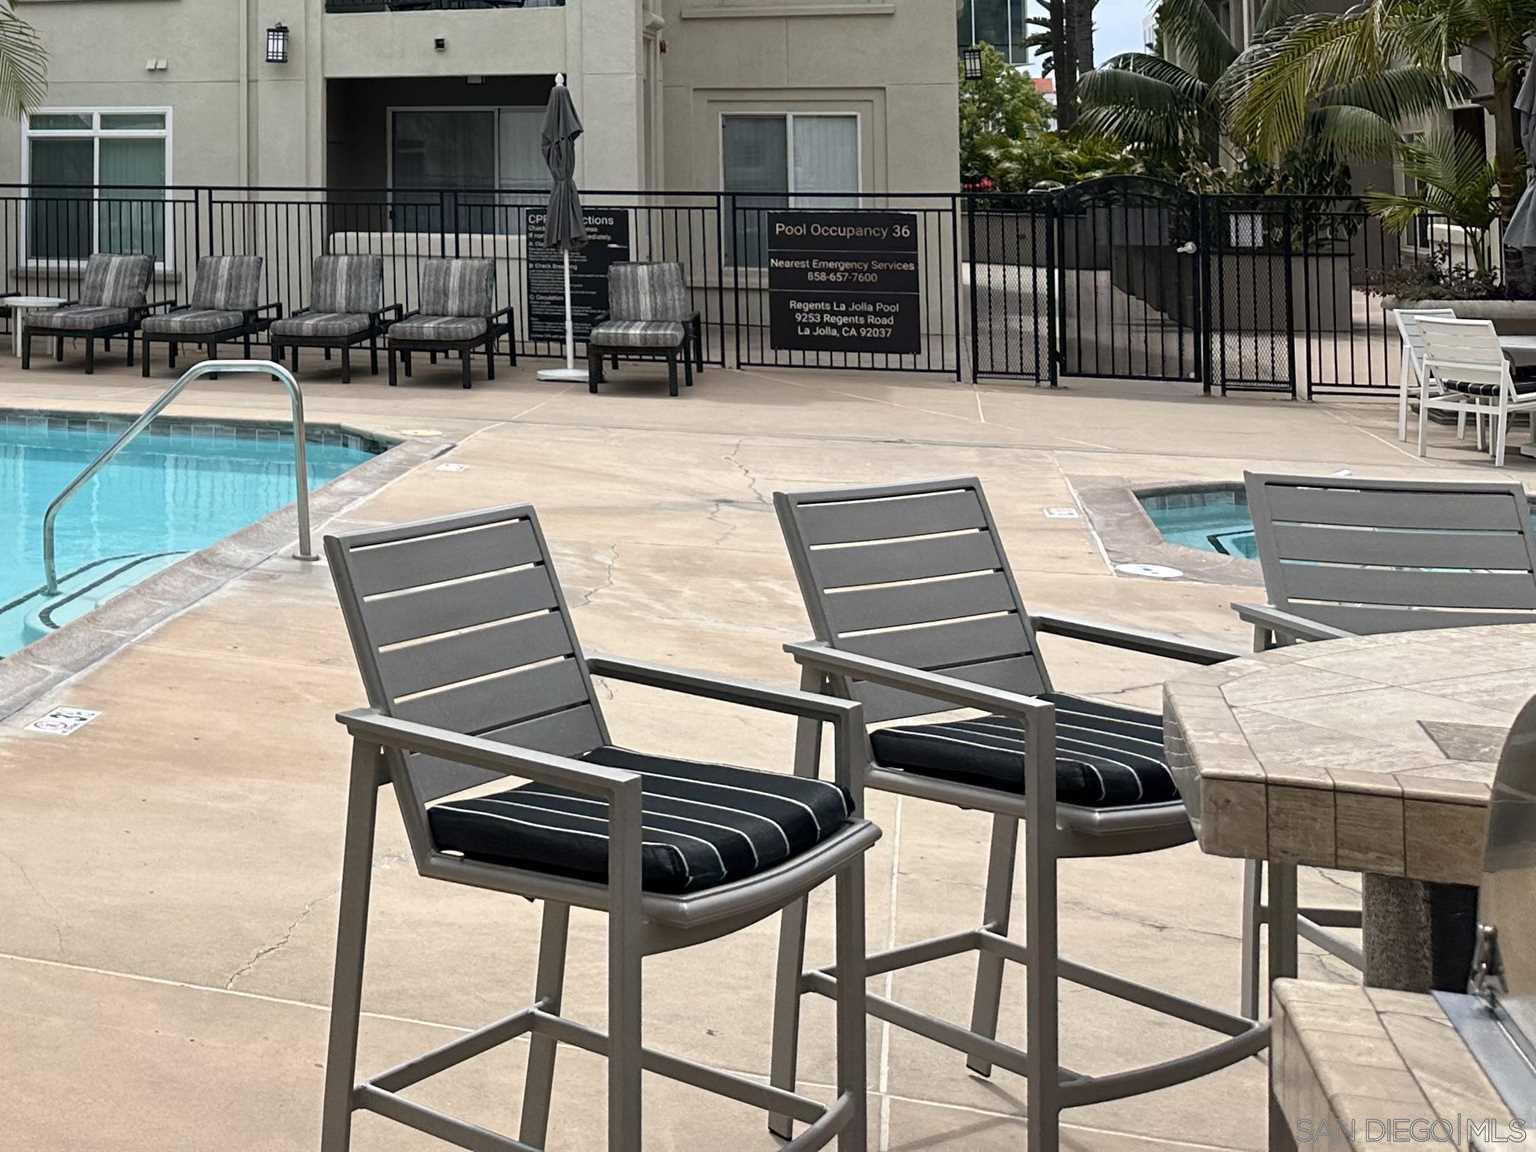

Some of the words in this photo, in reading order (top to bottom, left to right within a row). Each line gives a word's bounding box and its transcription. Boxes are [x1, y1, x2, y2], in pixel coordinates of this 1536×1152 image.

[583, 215, 614, 225] ctions
[775, 222, 806, 236] Pool
[810, 223, 889, 239] Occupancy
[892, 224, 910, 237] 36
[770, 258, 810, 268] Nearest
[812, 259, 868, 271] Emergency
[871, 260, 914, 271] Services
[807, 271, 878, 282] 858-657-7600
[789, 300, 831, 312] Regents
[833, 301, 846, 311] La
[848, 302, 873, 312] Jolla
[876, 302, 900, 313] Pool
[795, 313, 821, 323] 9253
[823, 314, 865, 326] Regents
[867, 315, 894, 325] Road
[797, 325, 810, 335] La
[812, 326, 840, 337] Jolla,
[841, 326, 857, 337] CA
[860, 327, 892, 338] 92037
